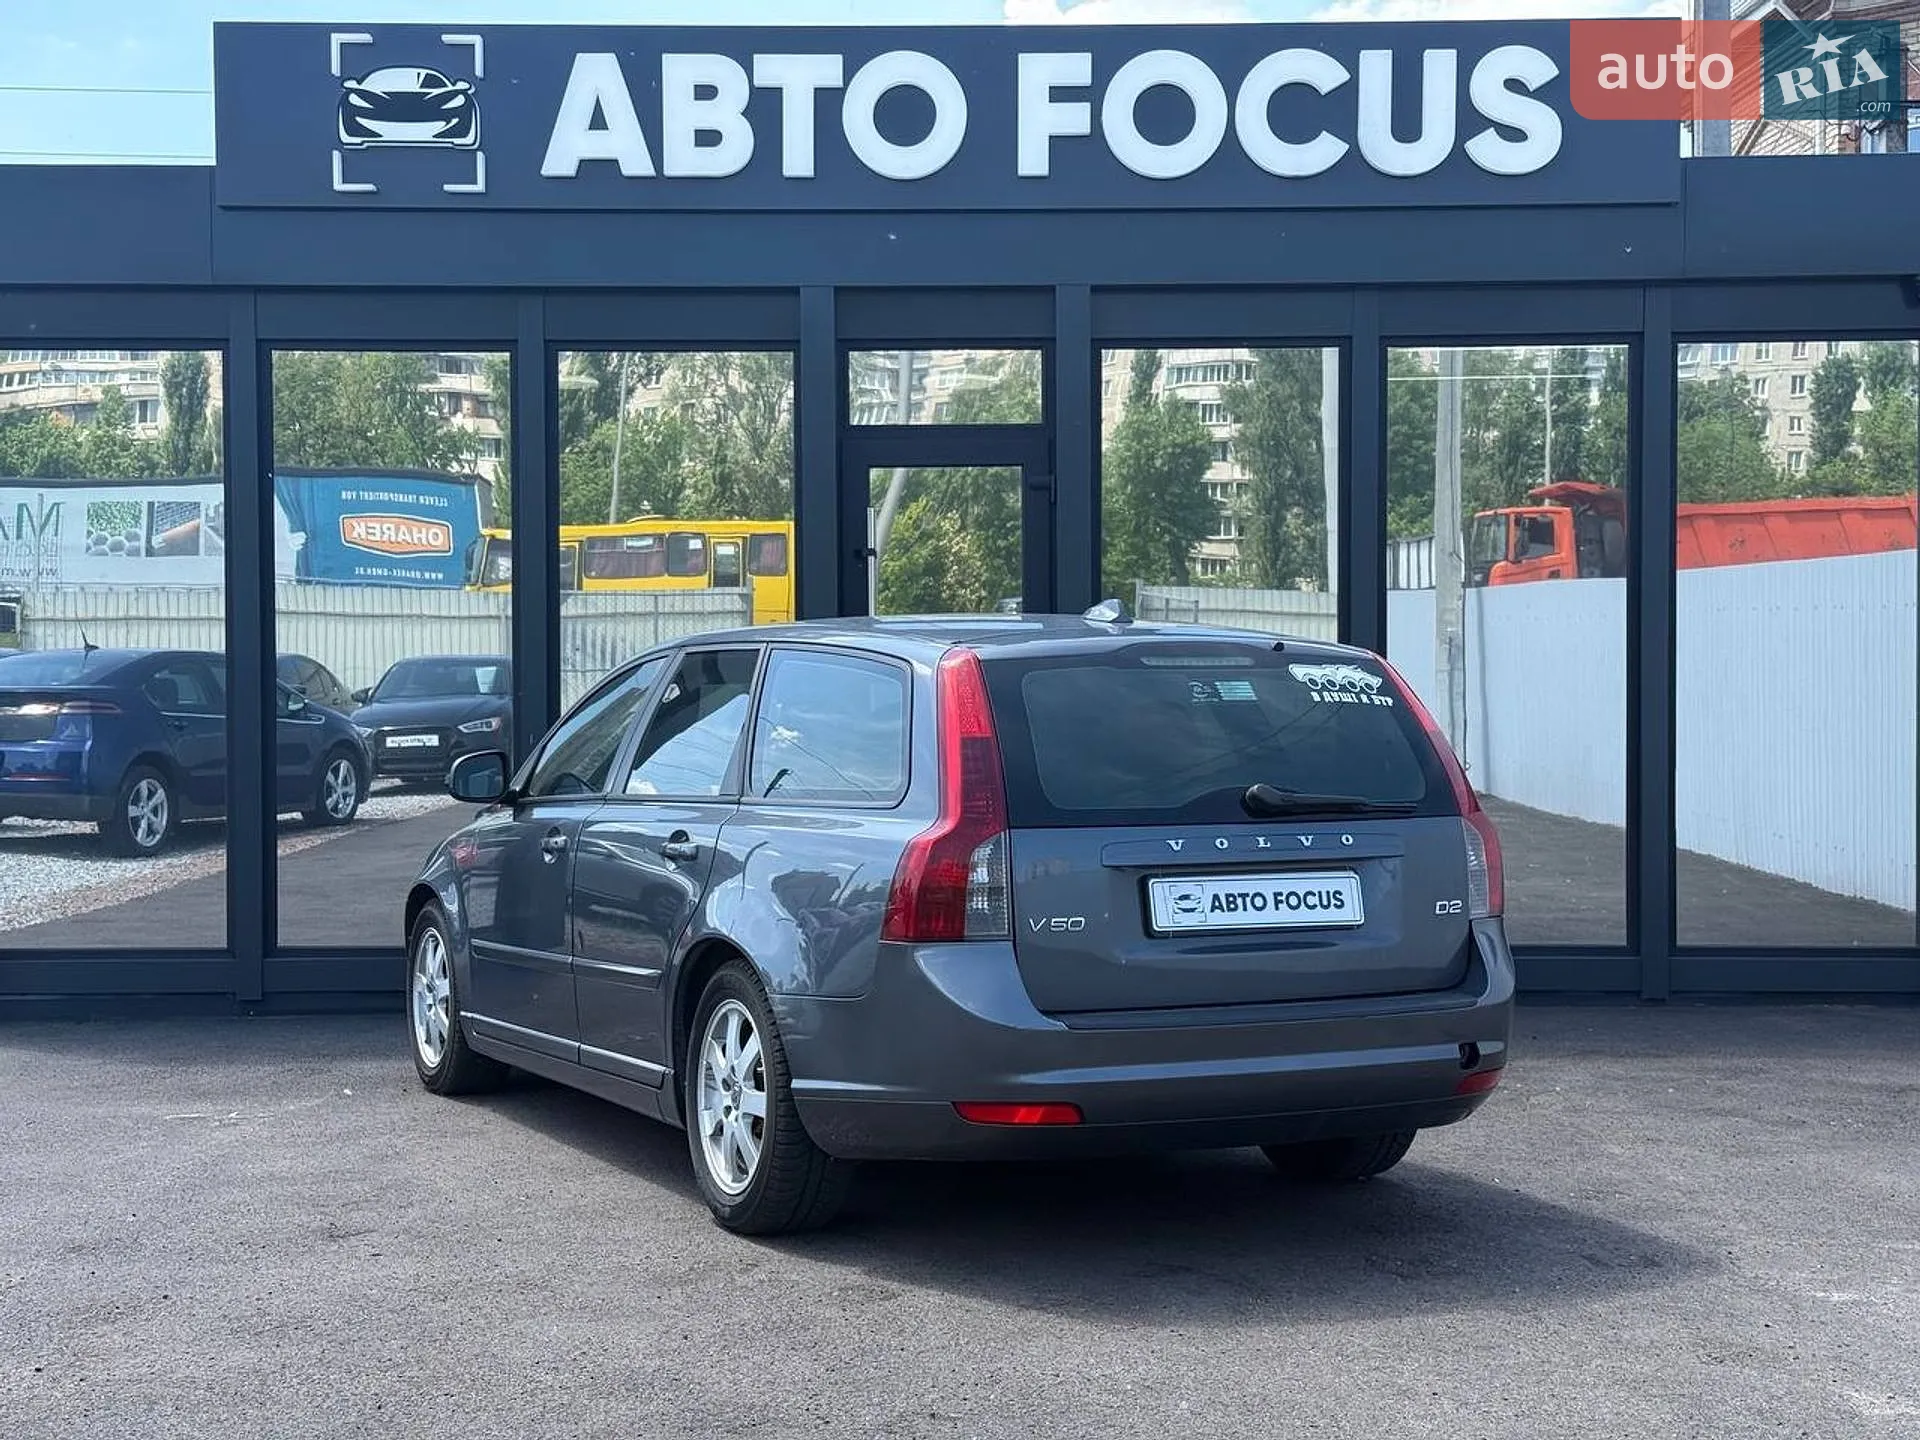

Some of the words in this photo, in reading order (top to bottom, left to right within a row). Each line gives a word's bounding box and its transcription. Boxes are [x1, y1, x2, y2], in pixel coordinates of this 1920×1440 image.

[540, 49, 968, 180] АВТО
[1017, 45, 1563, 179] FOCUS
[1166, 834, 1354, 851] VOLVO
[1209, 891, 1268, 913] АВТО
[1273, 889, 1346, 911] FOCUS
[1435, 900, 1463, 915] D2
